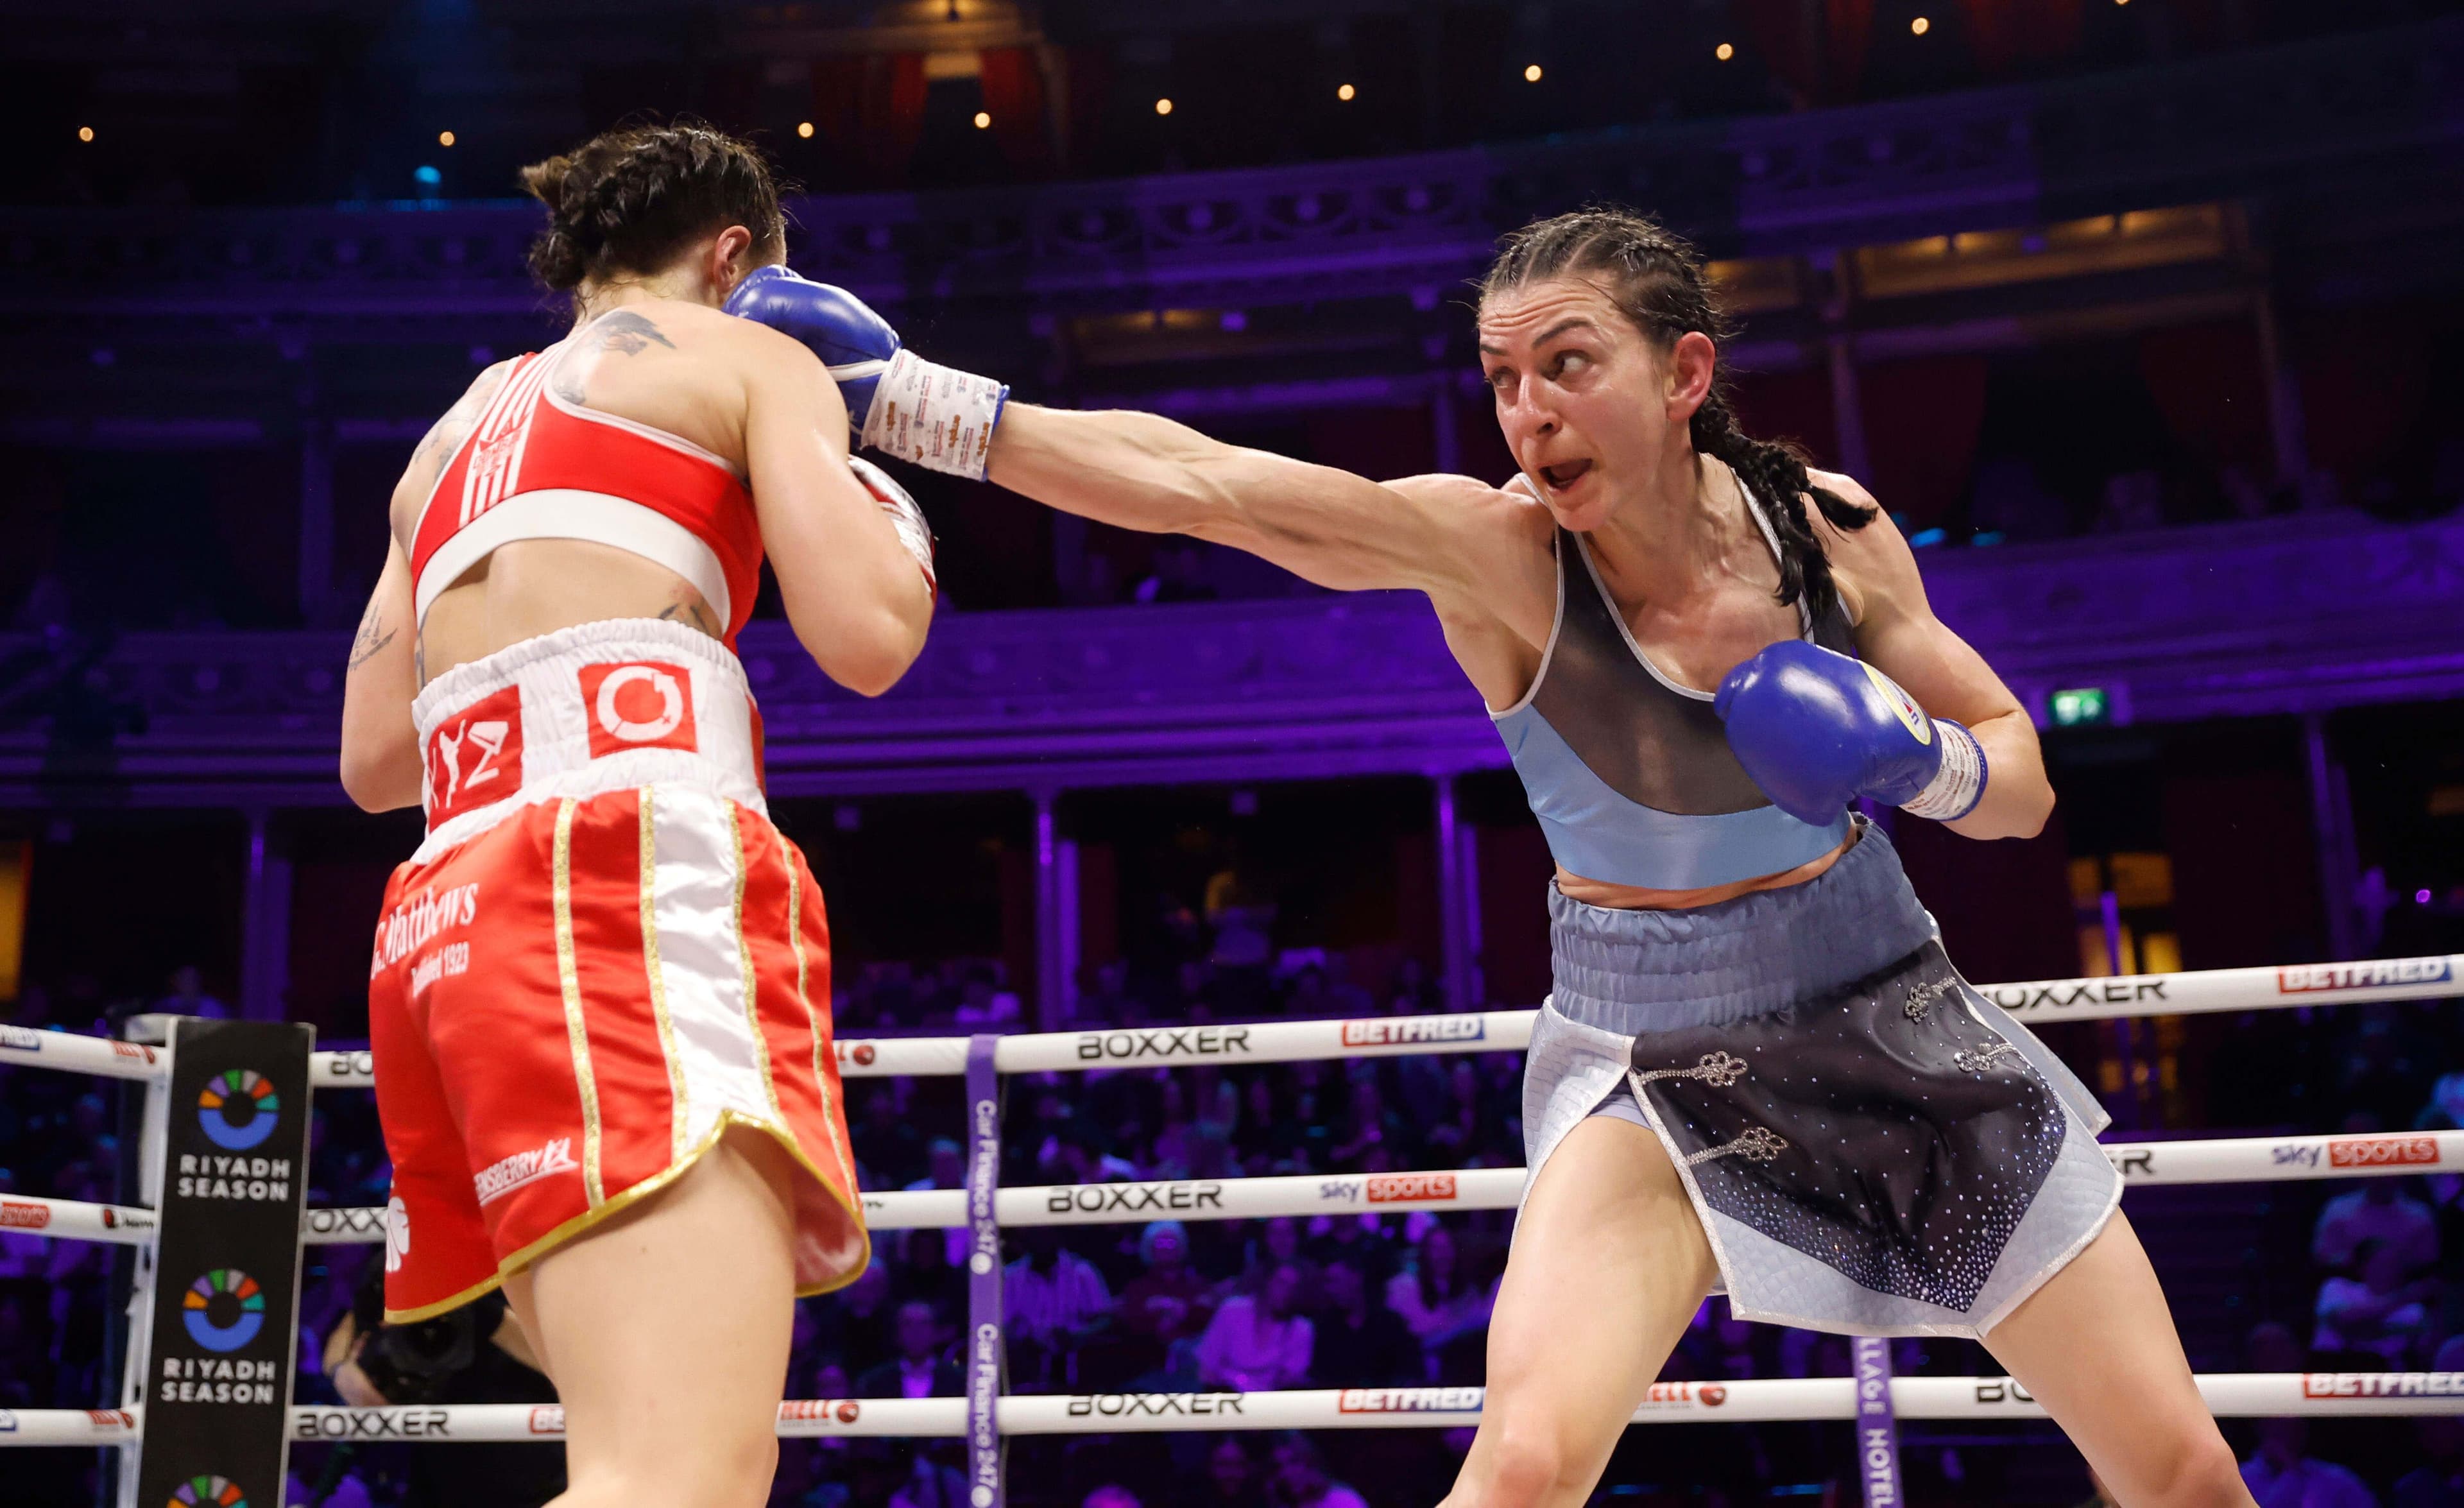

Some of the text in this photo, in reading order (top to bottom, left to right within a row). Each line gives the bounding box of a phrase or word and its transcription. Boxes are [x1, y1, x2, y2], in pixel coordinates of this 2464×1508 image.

[2285, 957, 2446, 990] BETFRED
[1984, 979, 2167, 1010] OXXER
[1346, 1014, 1483, 1044] BETFRED
[1078, 1027, 1251, 1060] BOXXER
[976, 1099, 997, 1137] Car
[180, 1154, 291, 1179] RIYADH
[2272, 1140, 2436, 1168] sky sports
[178, 1176, 289, 1202] SEASON
[973, 1140, 999, 1217] Finance
[1320, 1177, 1453, 1203] sky sports
[1048, 1185, 1224, 1212] BOXXER
[163, 1357, 276, 1381] RIYADH
[1858, 1337, 1887, 1414] LLAGE
[160, 1380, 274, 1404] SEASON
[974, 1323, 998, 1489] Car Finance 247
[1069, 1393, 1244, 1416] BOXXER
[1342, 1388, 1482, 1412] BETFRED
[298, 1411, 449, 1437] BOXXER
[1865, 1428, 1895, 1508] HOTEL
